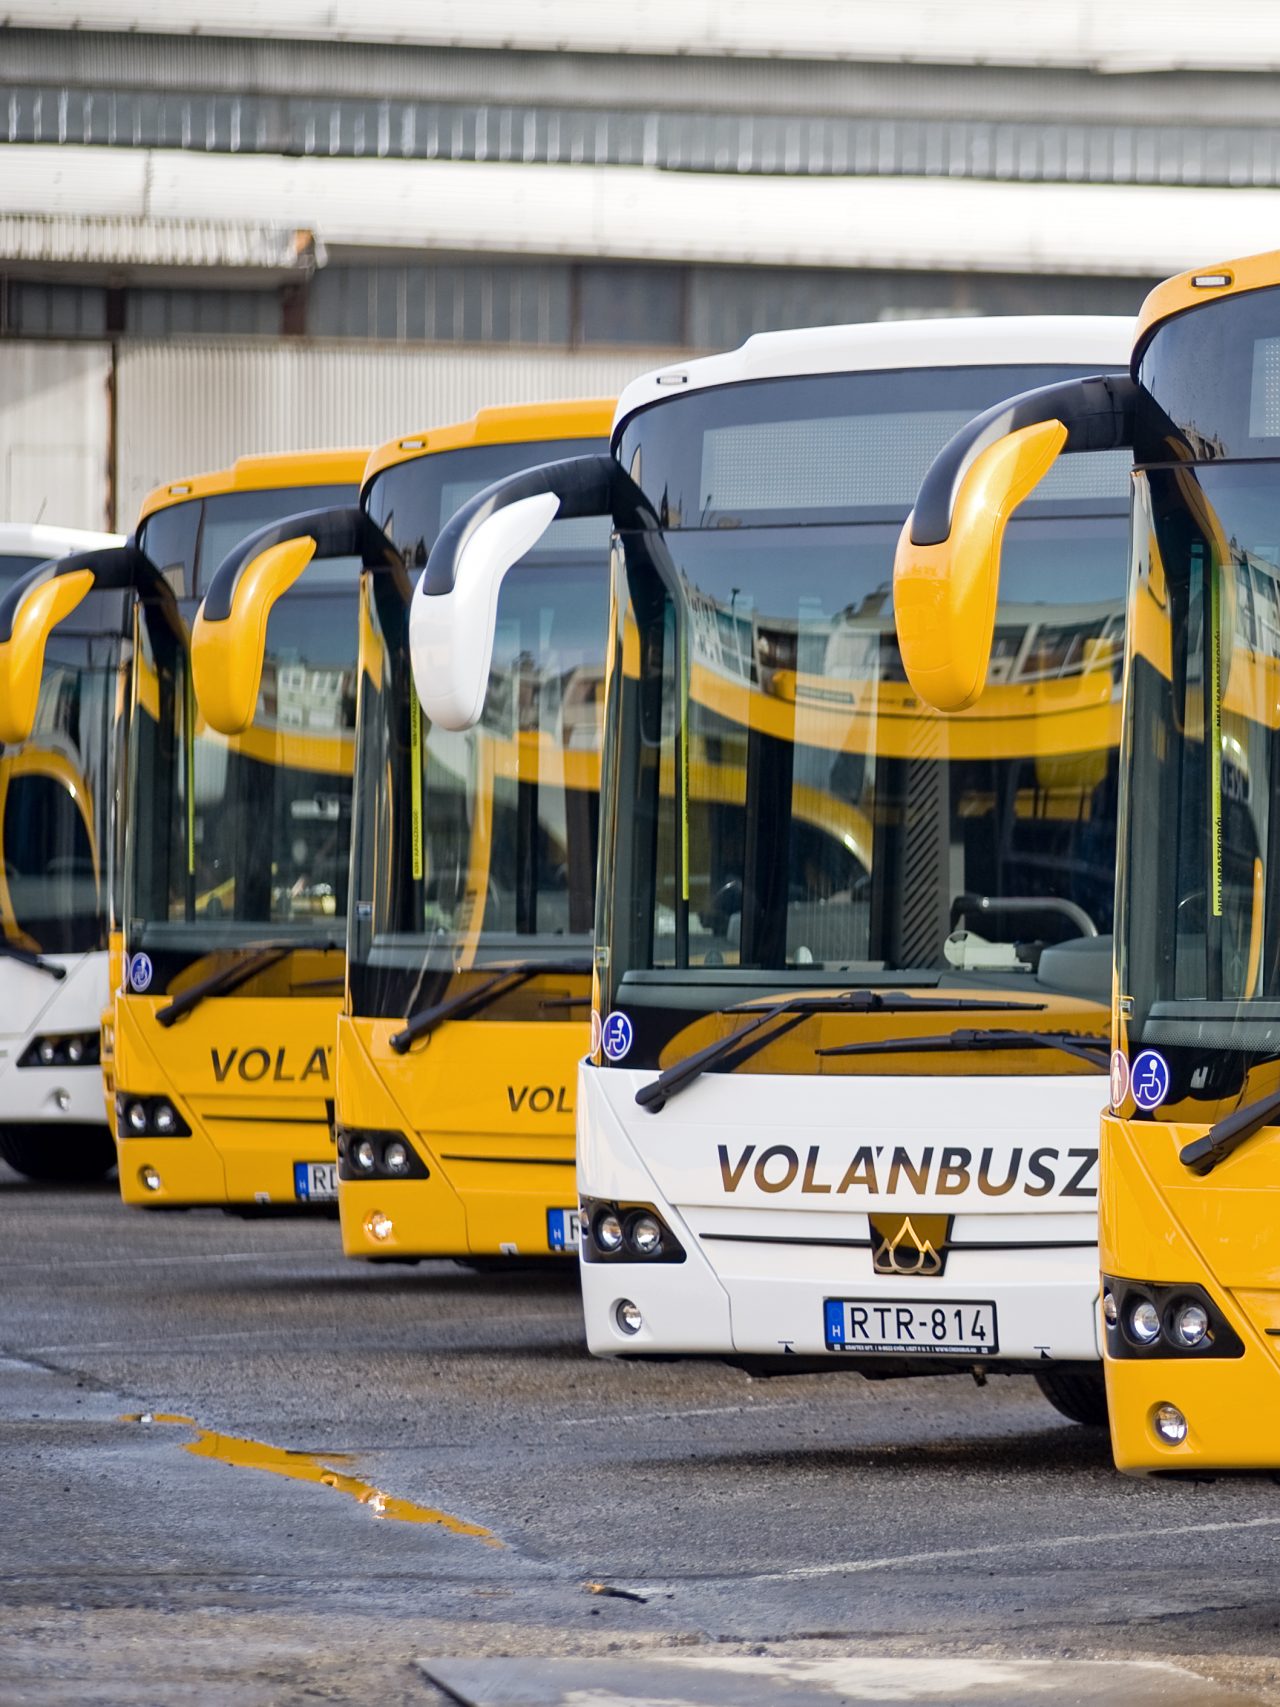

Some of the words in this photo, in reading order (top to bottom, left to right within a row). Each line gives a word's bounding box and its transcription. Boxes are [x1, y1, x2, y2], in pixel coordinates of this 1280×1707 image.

[717, 1144, 1099, 1197] VOLÁNBUSZ
[832, 1325, 841, 1337] H
[850, 1307, 986, 1341] RTR-814
